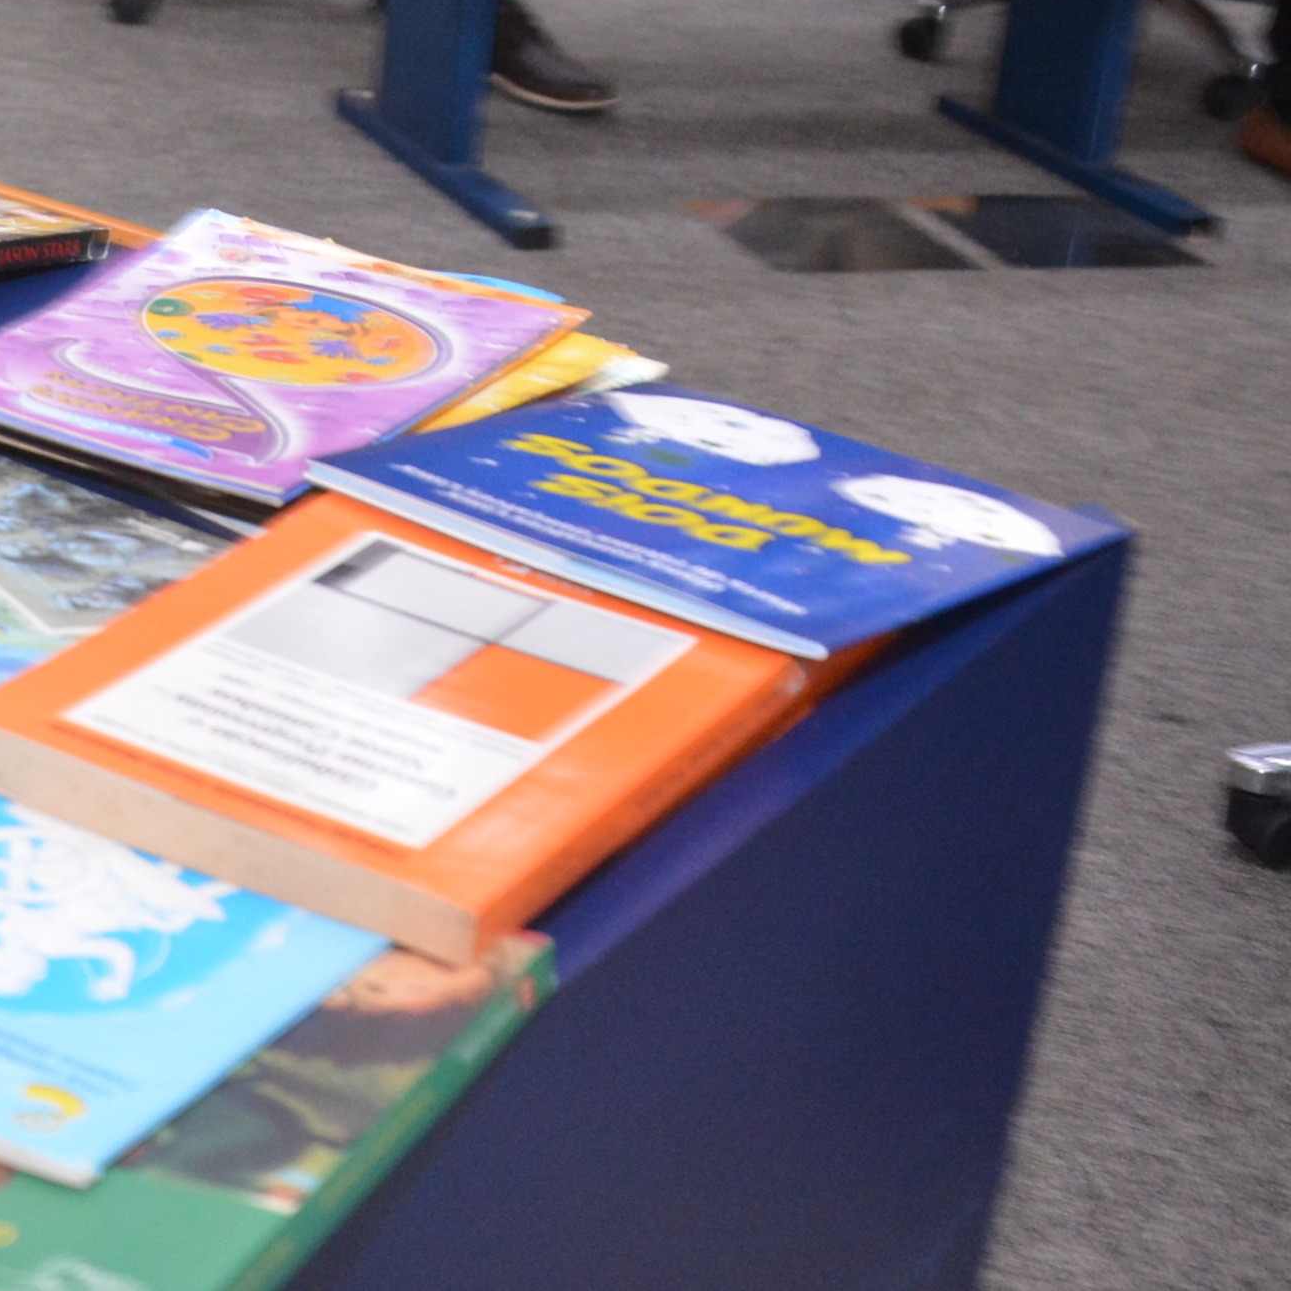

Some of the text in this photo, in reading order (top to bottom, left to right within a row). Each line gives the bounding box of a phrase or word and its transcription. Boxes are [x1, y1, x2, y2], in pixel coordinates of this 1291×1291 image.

[42, 239, 81, 261] STARR
[500, 432, 910, 565] MUNDOS
[527, 472, 777, 553] DOIS
